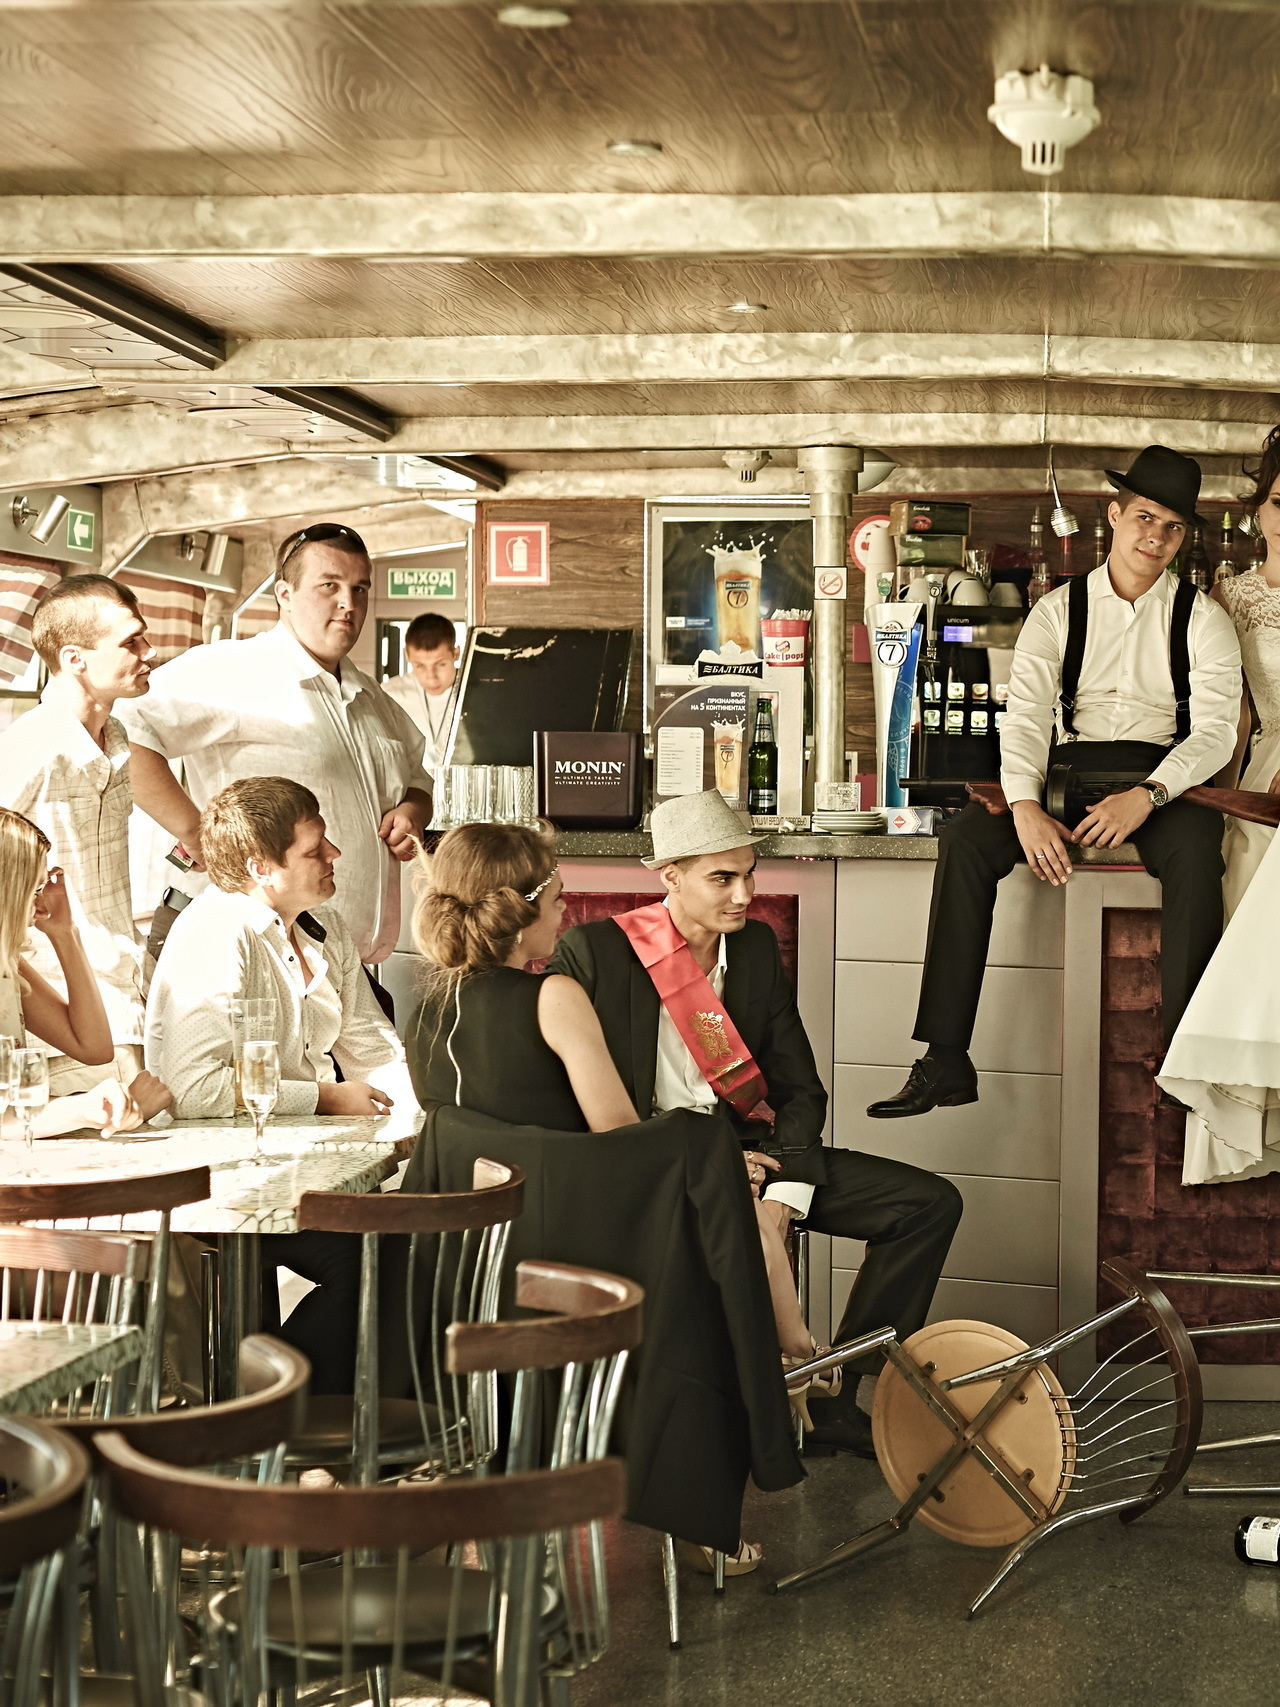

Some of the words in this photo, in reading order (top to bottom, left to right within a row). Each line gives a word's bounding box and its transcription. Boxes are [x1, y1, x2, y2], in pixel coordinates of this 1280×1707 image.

[393, 571, 452, 587] ВЫХОД
[408, 586, 437, 596] EXIT
[733, 591, 742, 605] 7
[764, 652, 781, 660] Cake
[785, 652, 804, 661] pops
[885, 644, 897, 661] 7
[712, 665, 759, 674] БАЛТИКА
[730, 691, 747, 699] ВКУС,
[699, 702, 705, 710] 5
[554, 760, 623, 774] MONIN
